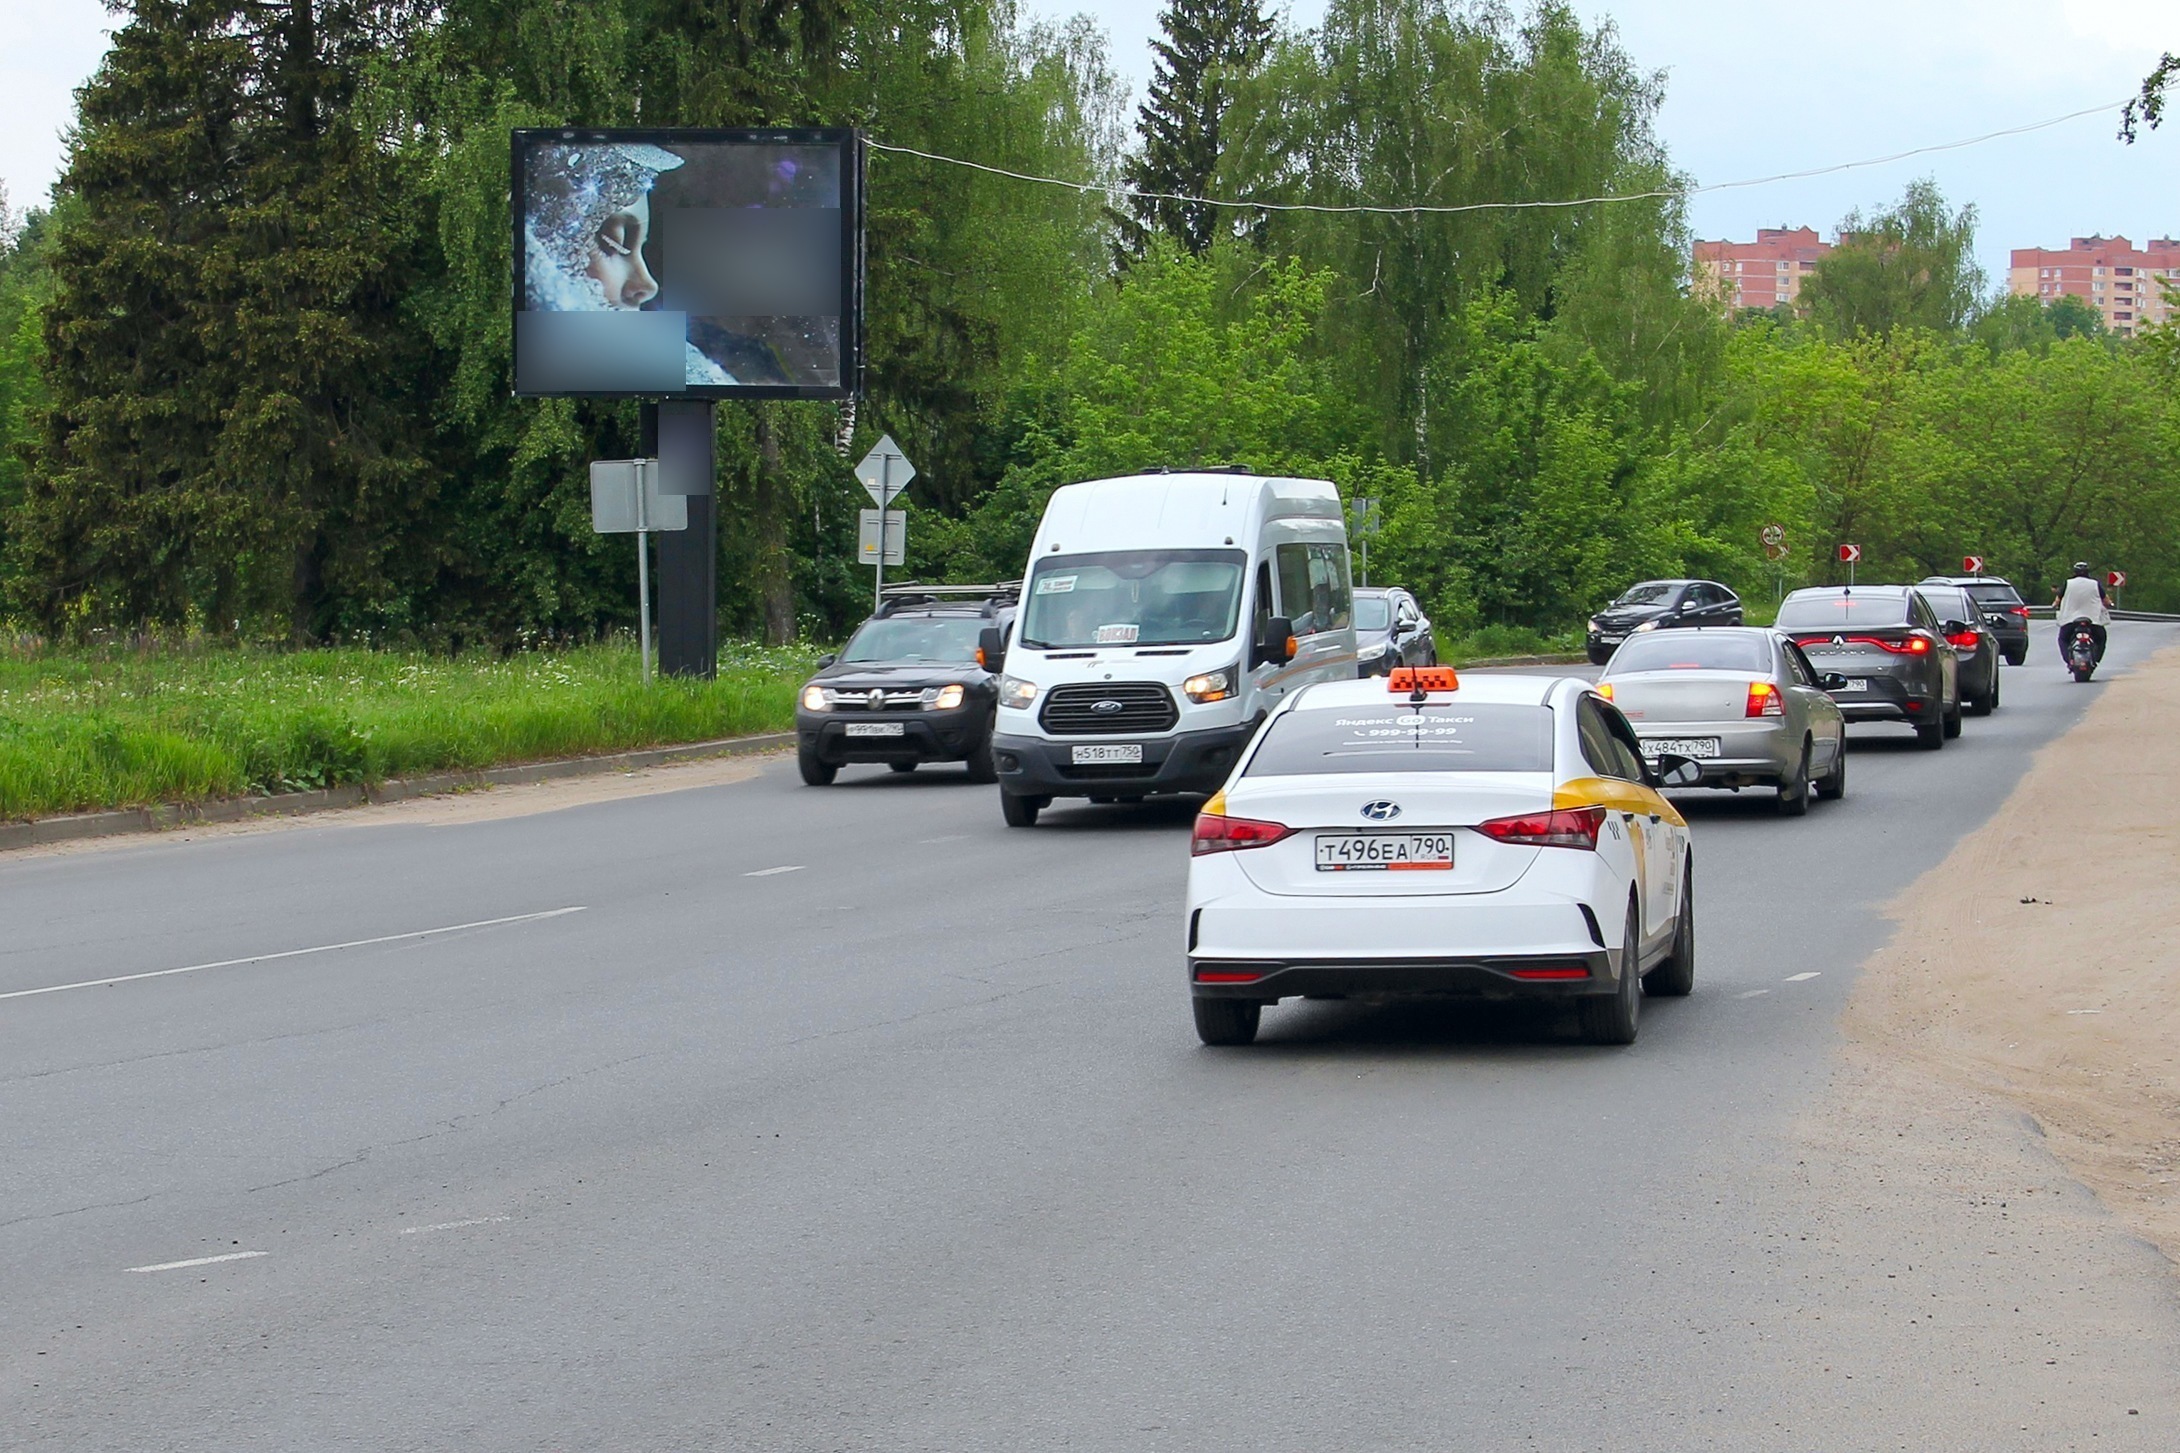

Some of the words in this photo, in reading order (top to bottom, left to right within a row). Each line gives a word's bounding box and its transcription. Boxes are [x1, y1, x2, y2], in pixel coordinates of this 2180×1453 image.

[1335, 718, 1394, 726] Яндекс
[1428, 716, 1474, 724] Такси
[1369, 727, 1457, 737] 999-99-99
[1694, 741, 1711, 749] 790
[1325, 839, 1408, 860] Т496ЕА
[1413, 838, 1445, 854] 790
